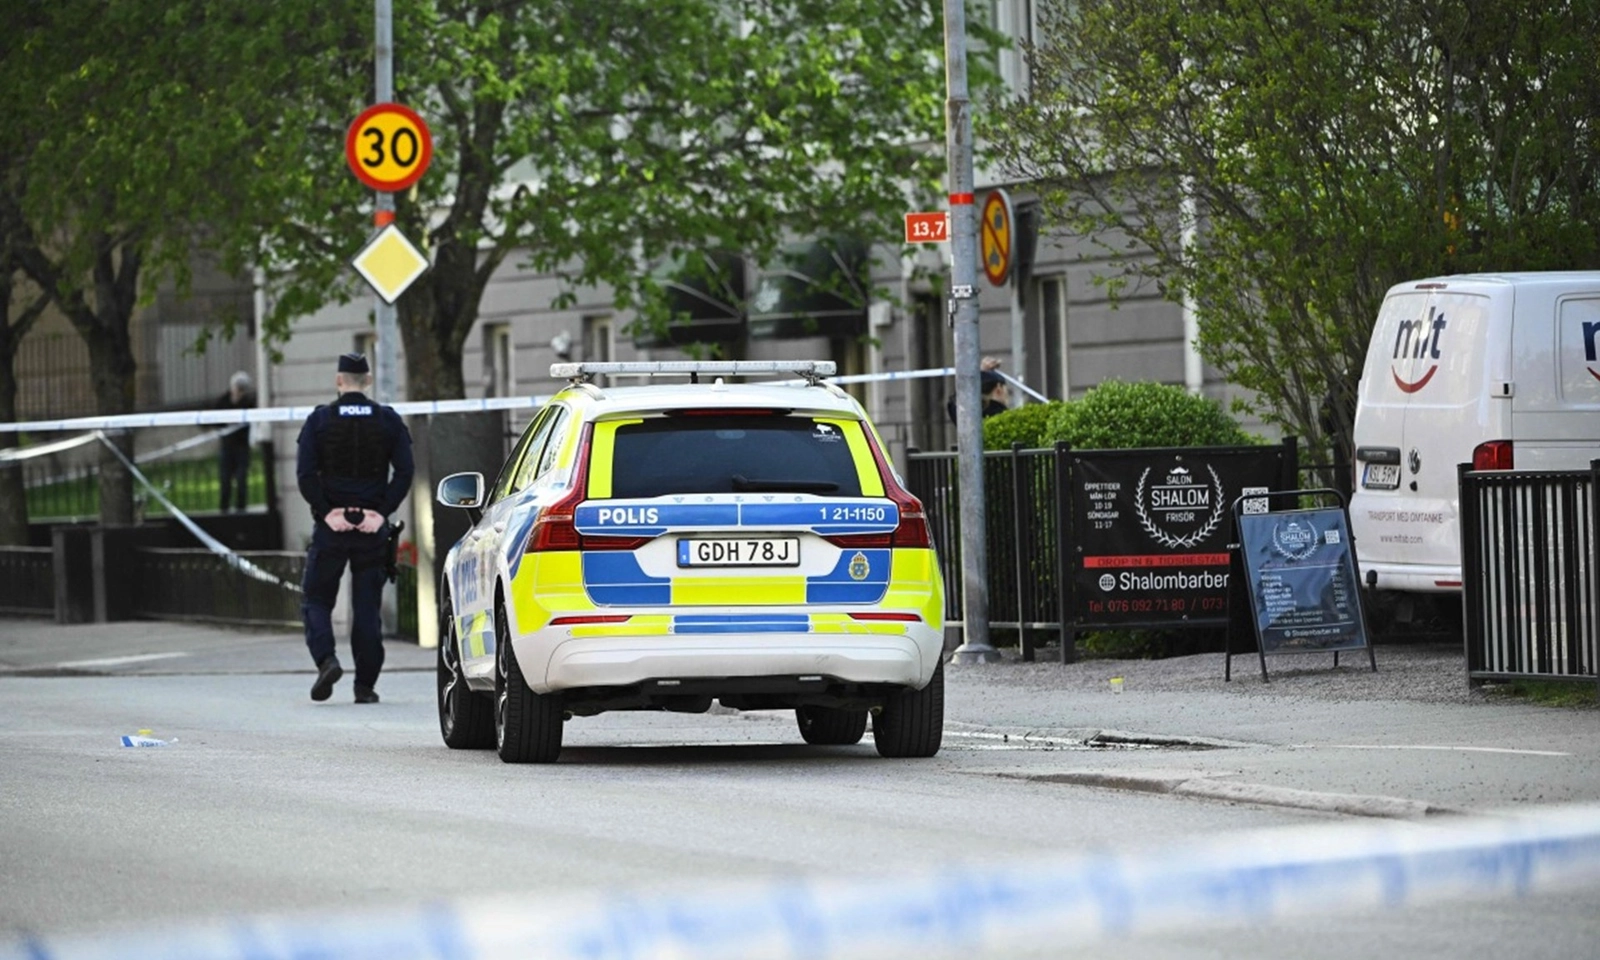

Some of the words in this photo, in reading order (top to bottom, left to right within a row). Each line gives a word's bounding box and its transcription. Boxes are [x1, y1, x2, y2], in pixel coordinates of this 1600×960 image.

[363, 127, 418, 168] 30
[913, 221, 944, 238] 13,7
[339, 405, 372, 415] POLIS
[1084, 482, 1121, 490] ÖPPETTIDER
[1166, 475, 1192, 485] SALON
[1151, 489, 1209, 506] SHALOM
[599, 508, 659, 525] POLIS
[820, 508, 827, 520] 1
[833, 508, 885, 521] 21-1150
[1166, 511, 1195, 522] FRISÖR
[1410, 512, 1443, 524] OMTANKE
[698, 542, 739, 561] GDH
[747, 541, 789, 561] 78J
[1097, 556, 1128, 567] DROP
[1130, 556, 1142, 566] IN
[1119, 571, 1229, 590] Shalombarber
[1108, 599, 1129, 612] 076
[1131, 599, 1152, 611] 092
[1155, 599, 1169, 611] 71
[1171, 598, 1185, 610] 80
